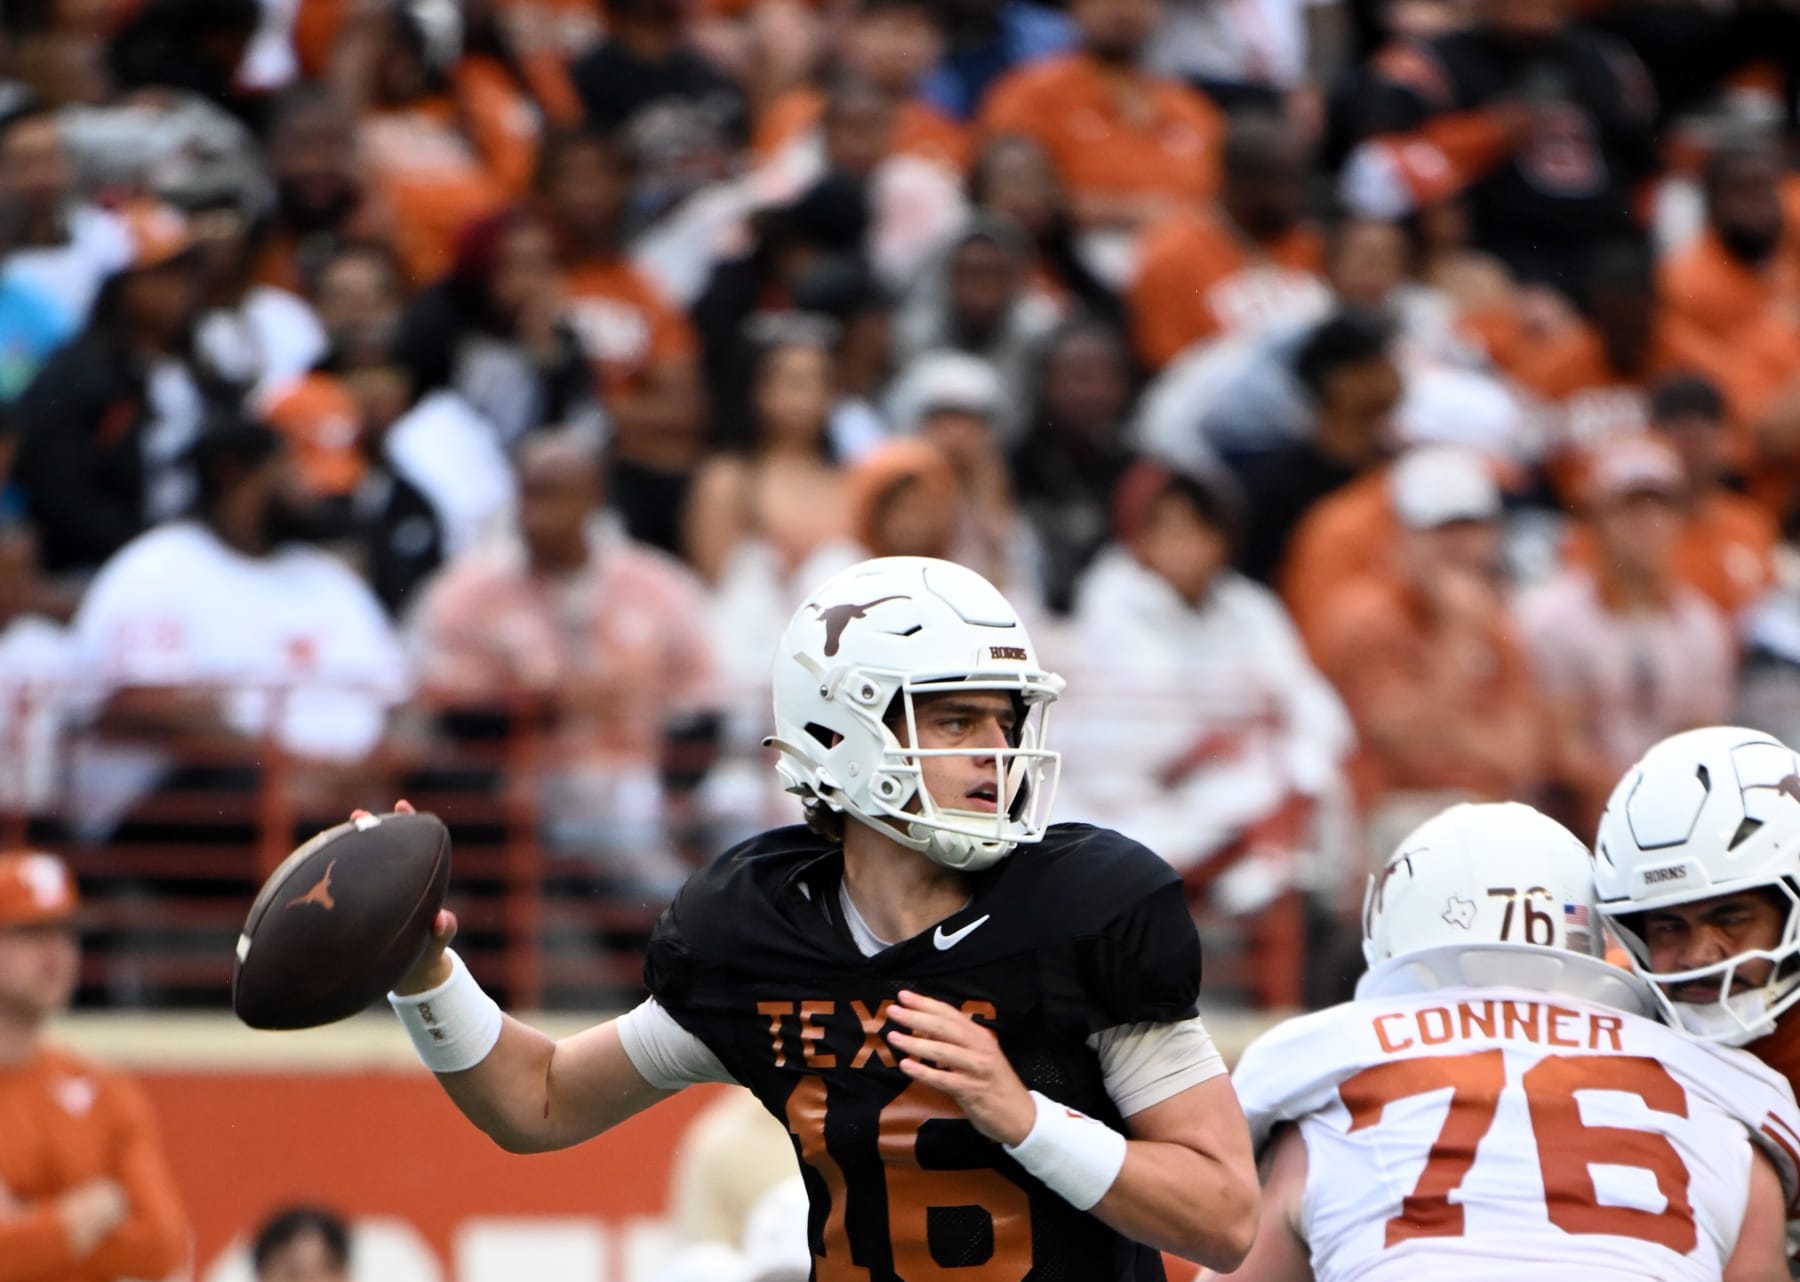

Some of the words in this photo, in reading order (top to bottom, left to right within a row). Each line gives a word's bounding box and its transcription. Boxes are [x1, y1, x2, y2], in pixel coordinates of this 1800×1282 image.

[1644, 865, 1686, 885] HORNS
[1487, 886, 1554, 946] 76
[757, 999, 999, 1069] TEX
[1373, 1000, 1623, 1053] CONNER
[1338, 1048, 1698, 1256] 76
